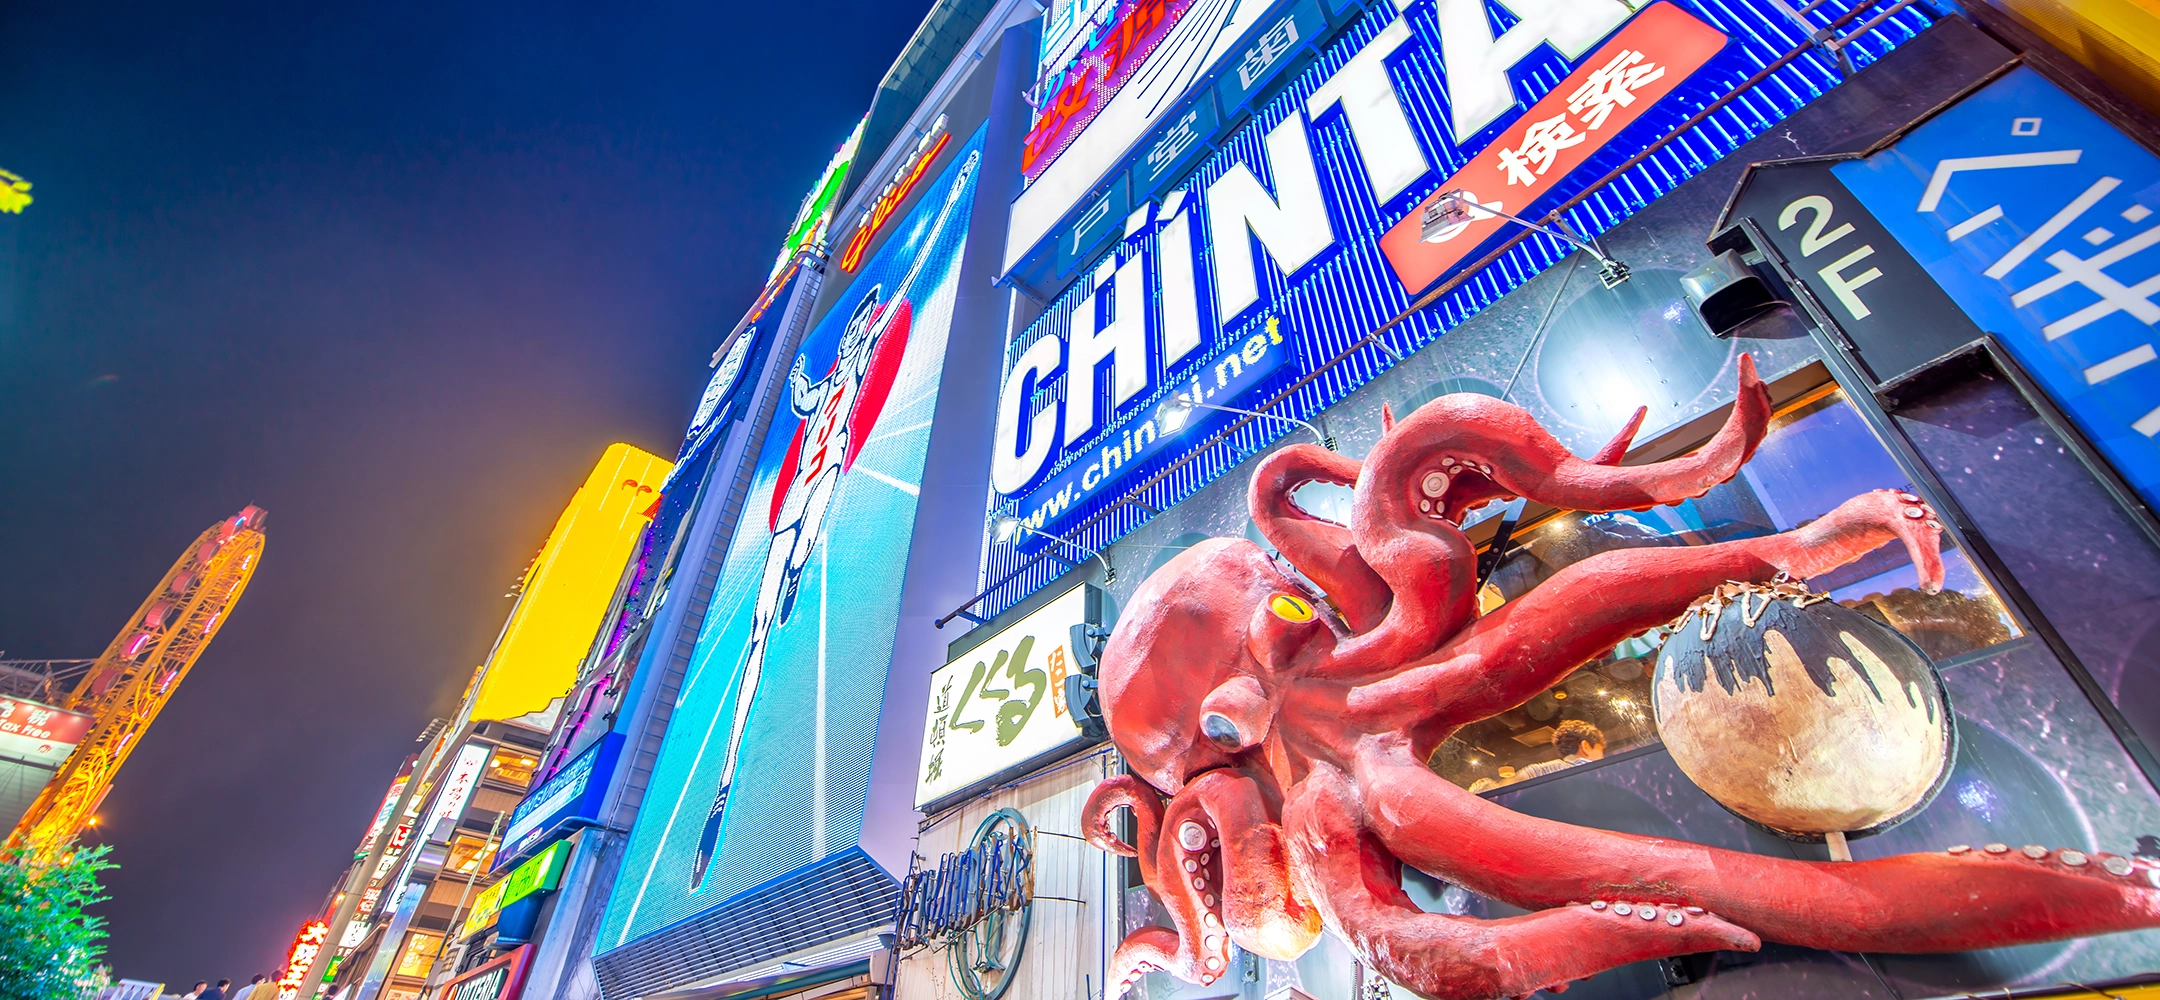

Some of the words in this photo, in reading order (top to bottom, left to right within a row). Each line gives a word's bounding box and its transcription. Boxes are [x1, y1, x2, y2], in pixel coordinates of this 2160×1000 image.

[1497, 49, 1666, 187] 検索
[1778, 194, 1883, 321] 2F
[20, 725, 52, 739] Free
[948, 634, 1047, 747] くくる
